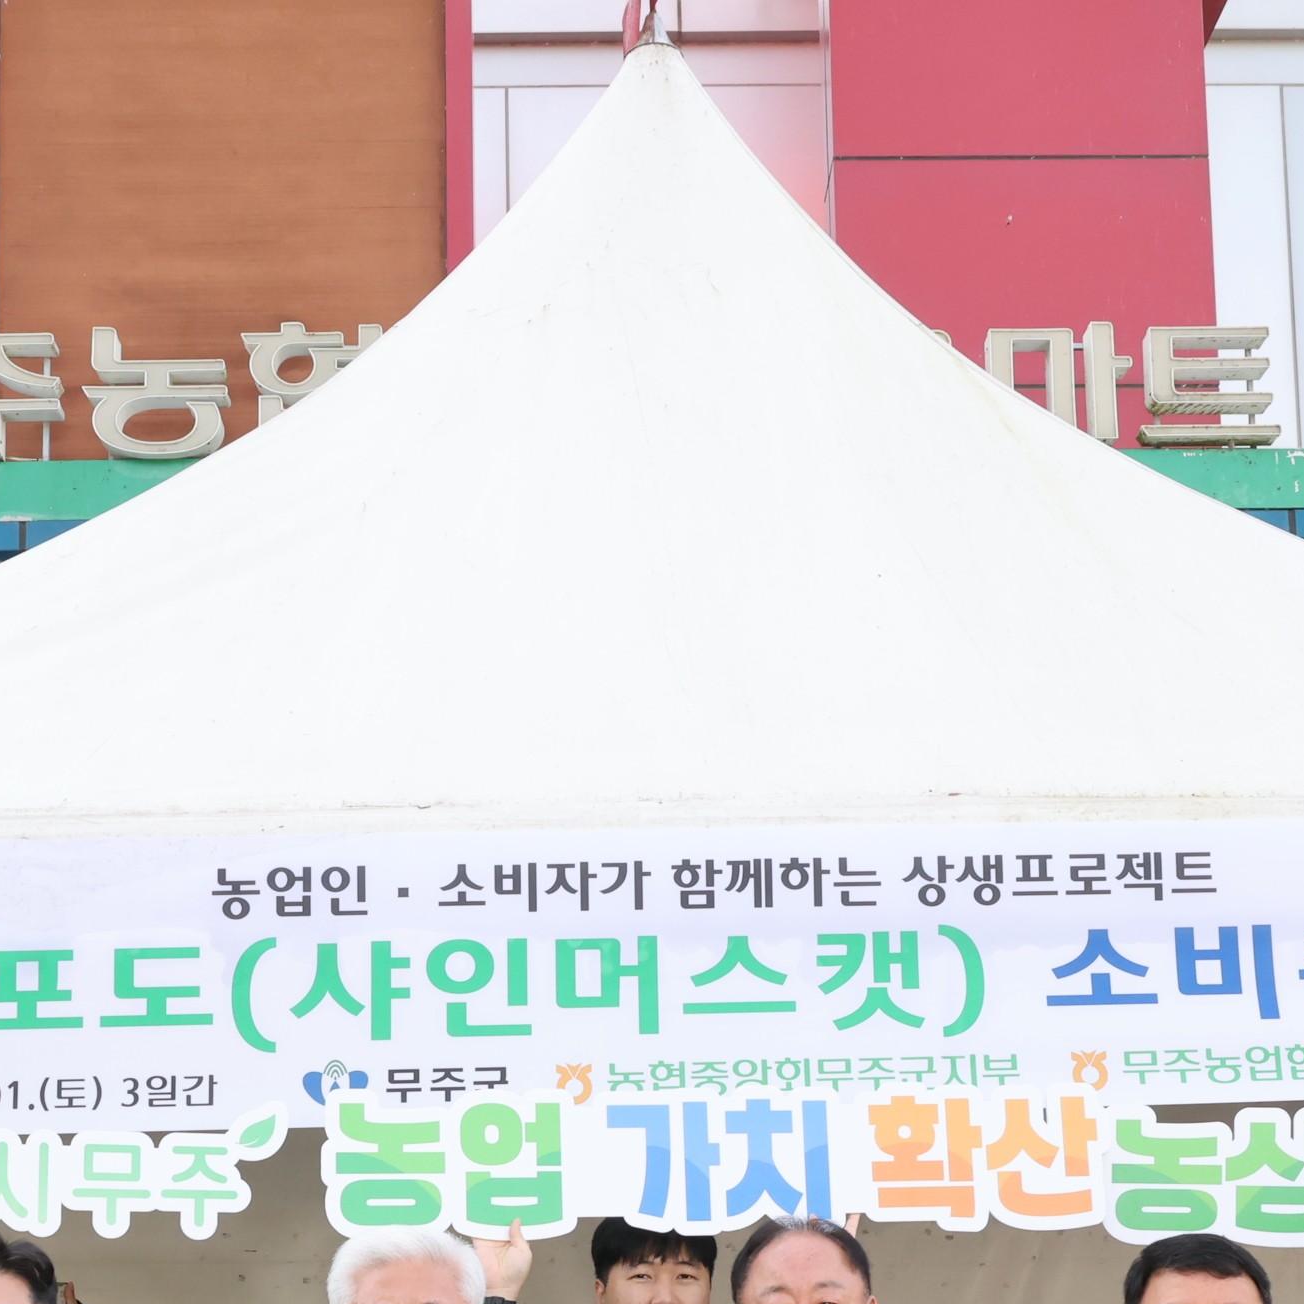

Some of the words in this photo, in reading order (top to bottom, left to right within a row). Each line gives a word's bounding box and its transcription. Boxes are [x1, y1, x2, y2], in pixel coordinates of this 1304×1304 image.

[930, 321, 1282, 448] 마트
[212, 865, 369, 920] 농업인
[437, 860, 652, 913] 소비자가
[671, 856, 881, 909] 함께하는
[901, 851, 1218, 906] 상생프로젝트
[121, 1073, 217, 1108] 3일간
[385, 1067, 510, 1102] 무주군
[609, 1052, 1020, 1094] 농협중앙회무주군지부
[335, 1101, 564, 1228] 농업
[606, 1098, 833, 1221] 가치
[868, 1095, 1099, 1219] 확산
